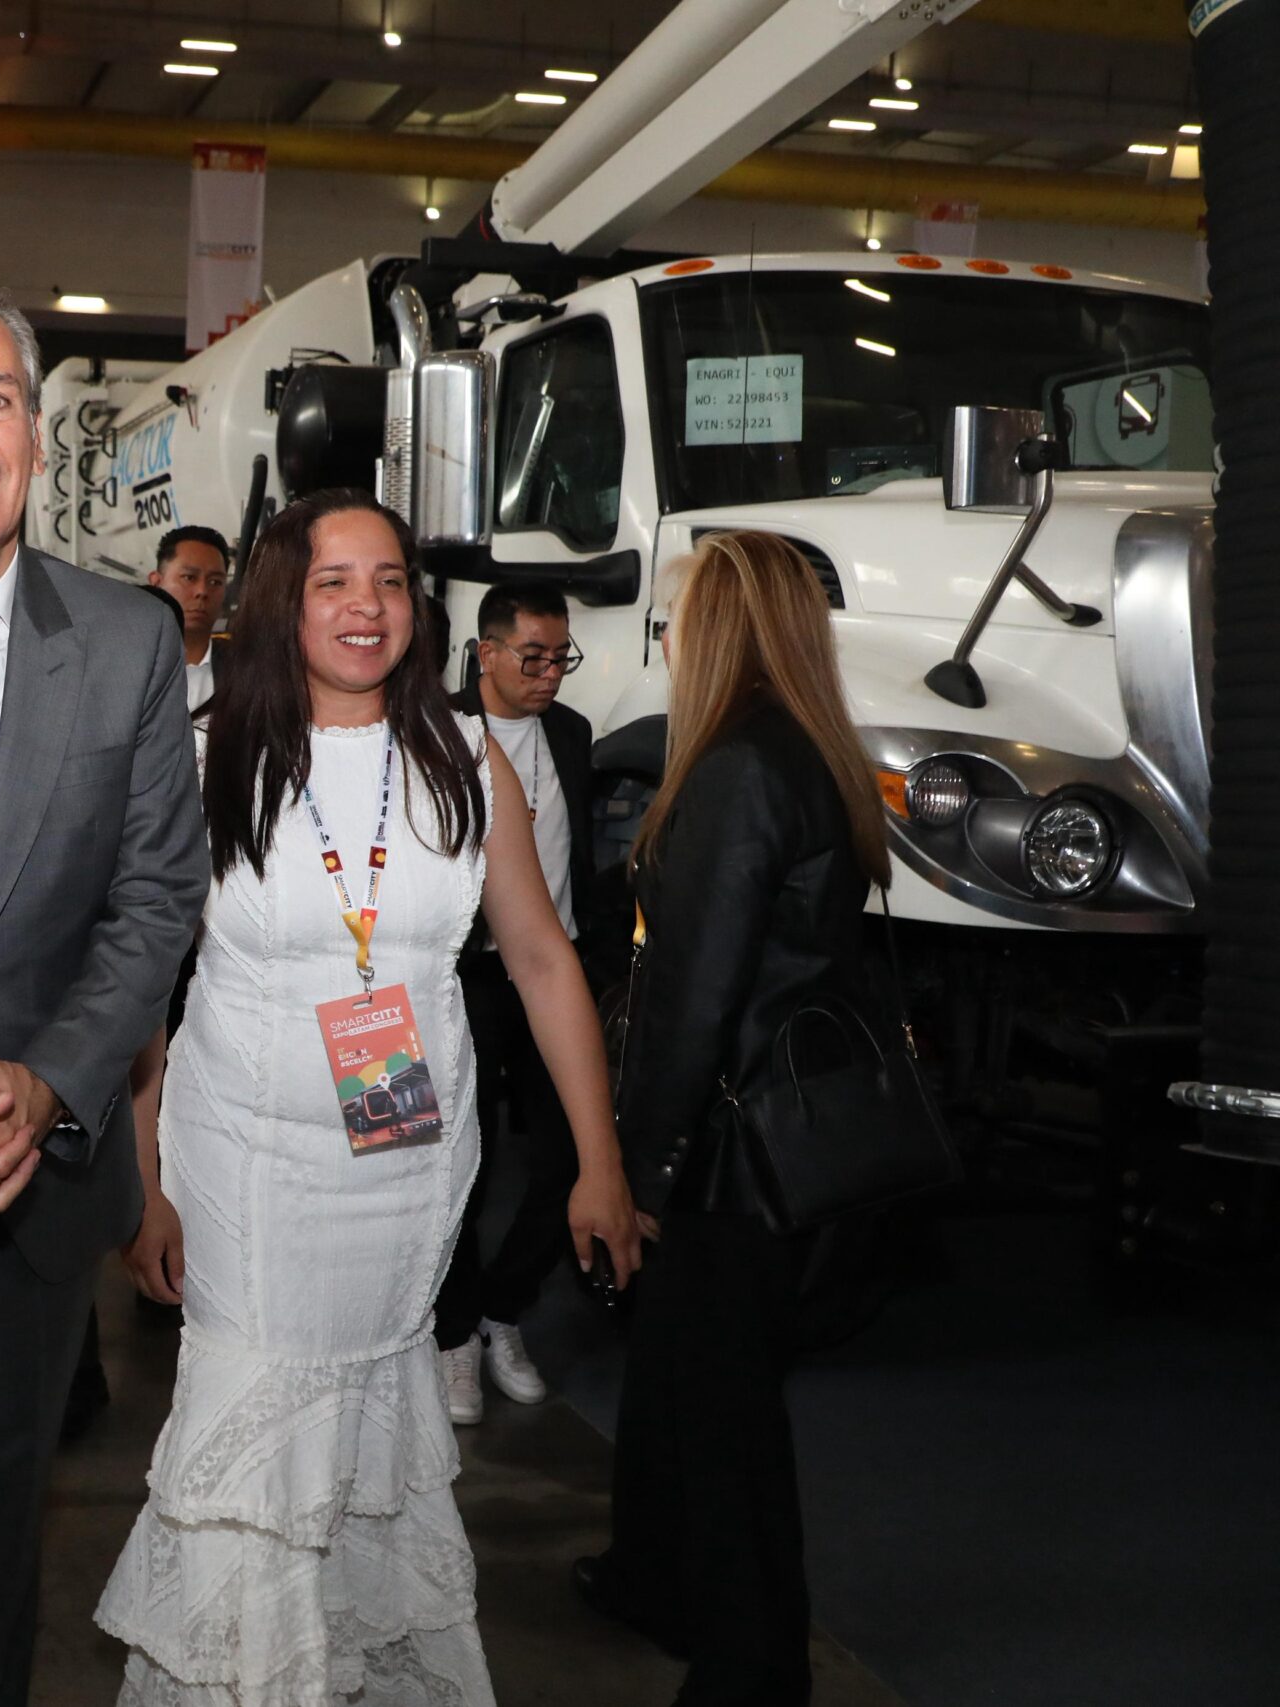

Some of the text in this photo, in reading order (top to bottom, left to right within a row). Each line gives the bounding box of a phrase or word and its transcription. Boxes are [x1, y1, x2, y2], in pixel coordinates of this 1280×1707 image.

[696, 369, 740, 380] ENAGRI
[765, 366, 796, 379] EQUI
[695, 394, 716, 406] WO:
[134, 490, 172, 530] 2100
[329, 1006, 401, 1033] SMARTCITY
